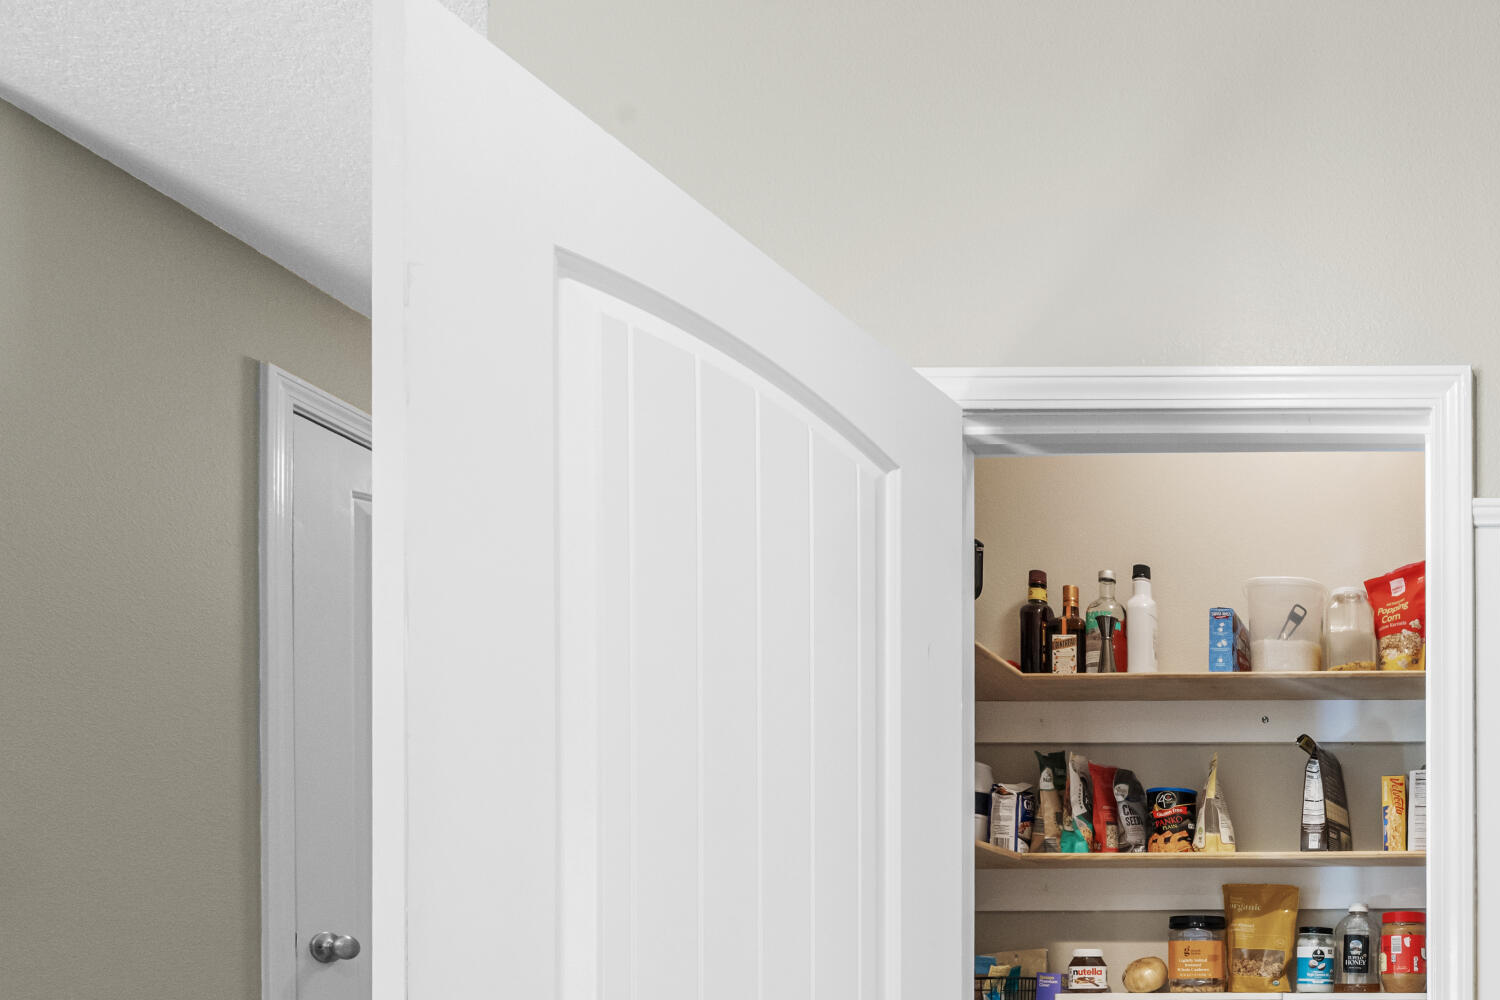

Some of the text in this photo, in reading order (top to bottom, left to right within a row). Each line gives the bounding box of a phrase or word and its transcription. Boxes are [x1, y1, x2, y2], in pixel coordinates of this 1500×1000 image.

[1378, 601, 1409, 616] Popping
[1382, 613, 1401, 624] Corn
[1158, 793, 1173, 808] 4C
[1390, 778, 1405, 816] Velveeta
[1155, 815, 1183, 828] PANKO
[1073, 968, 1103, 976] nutella
